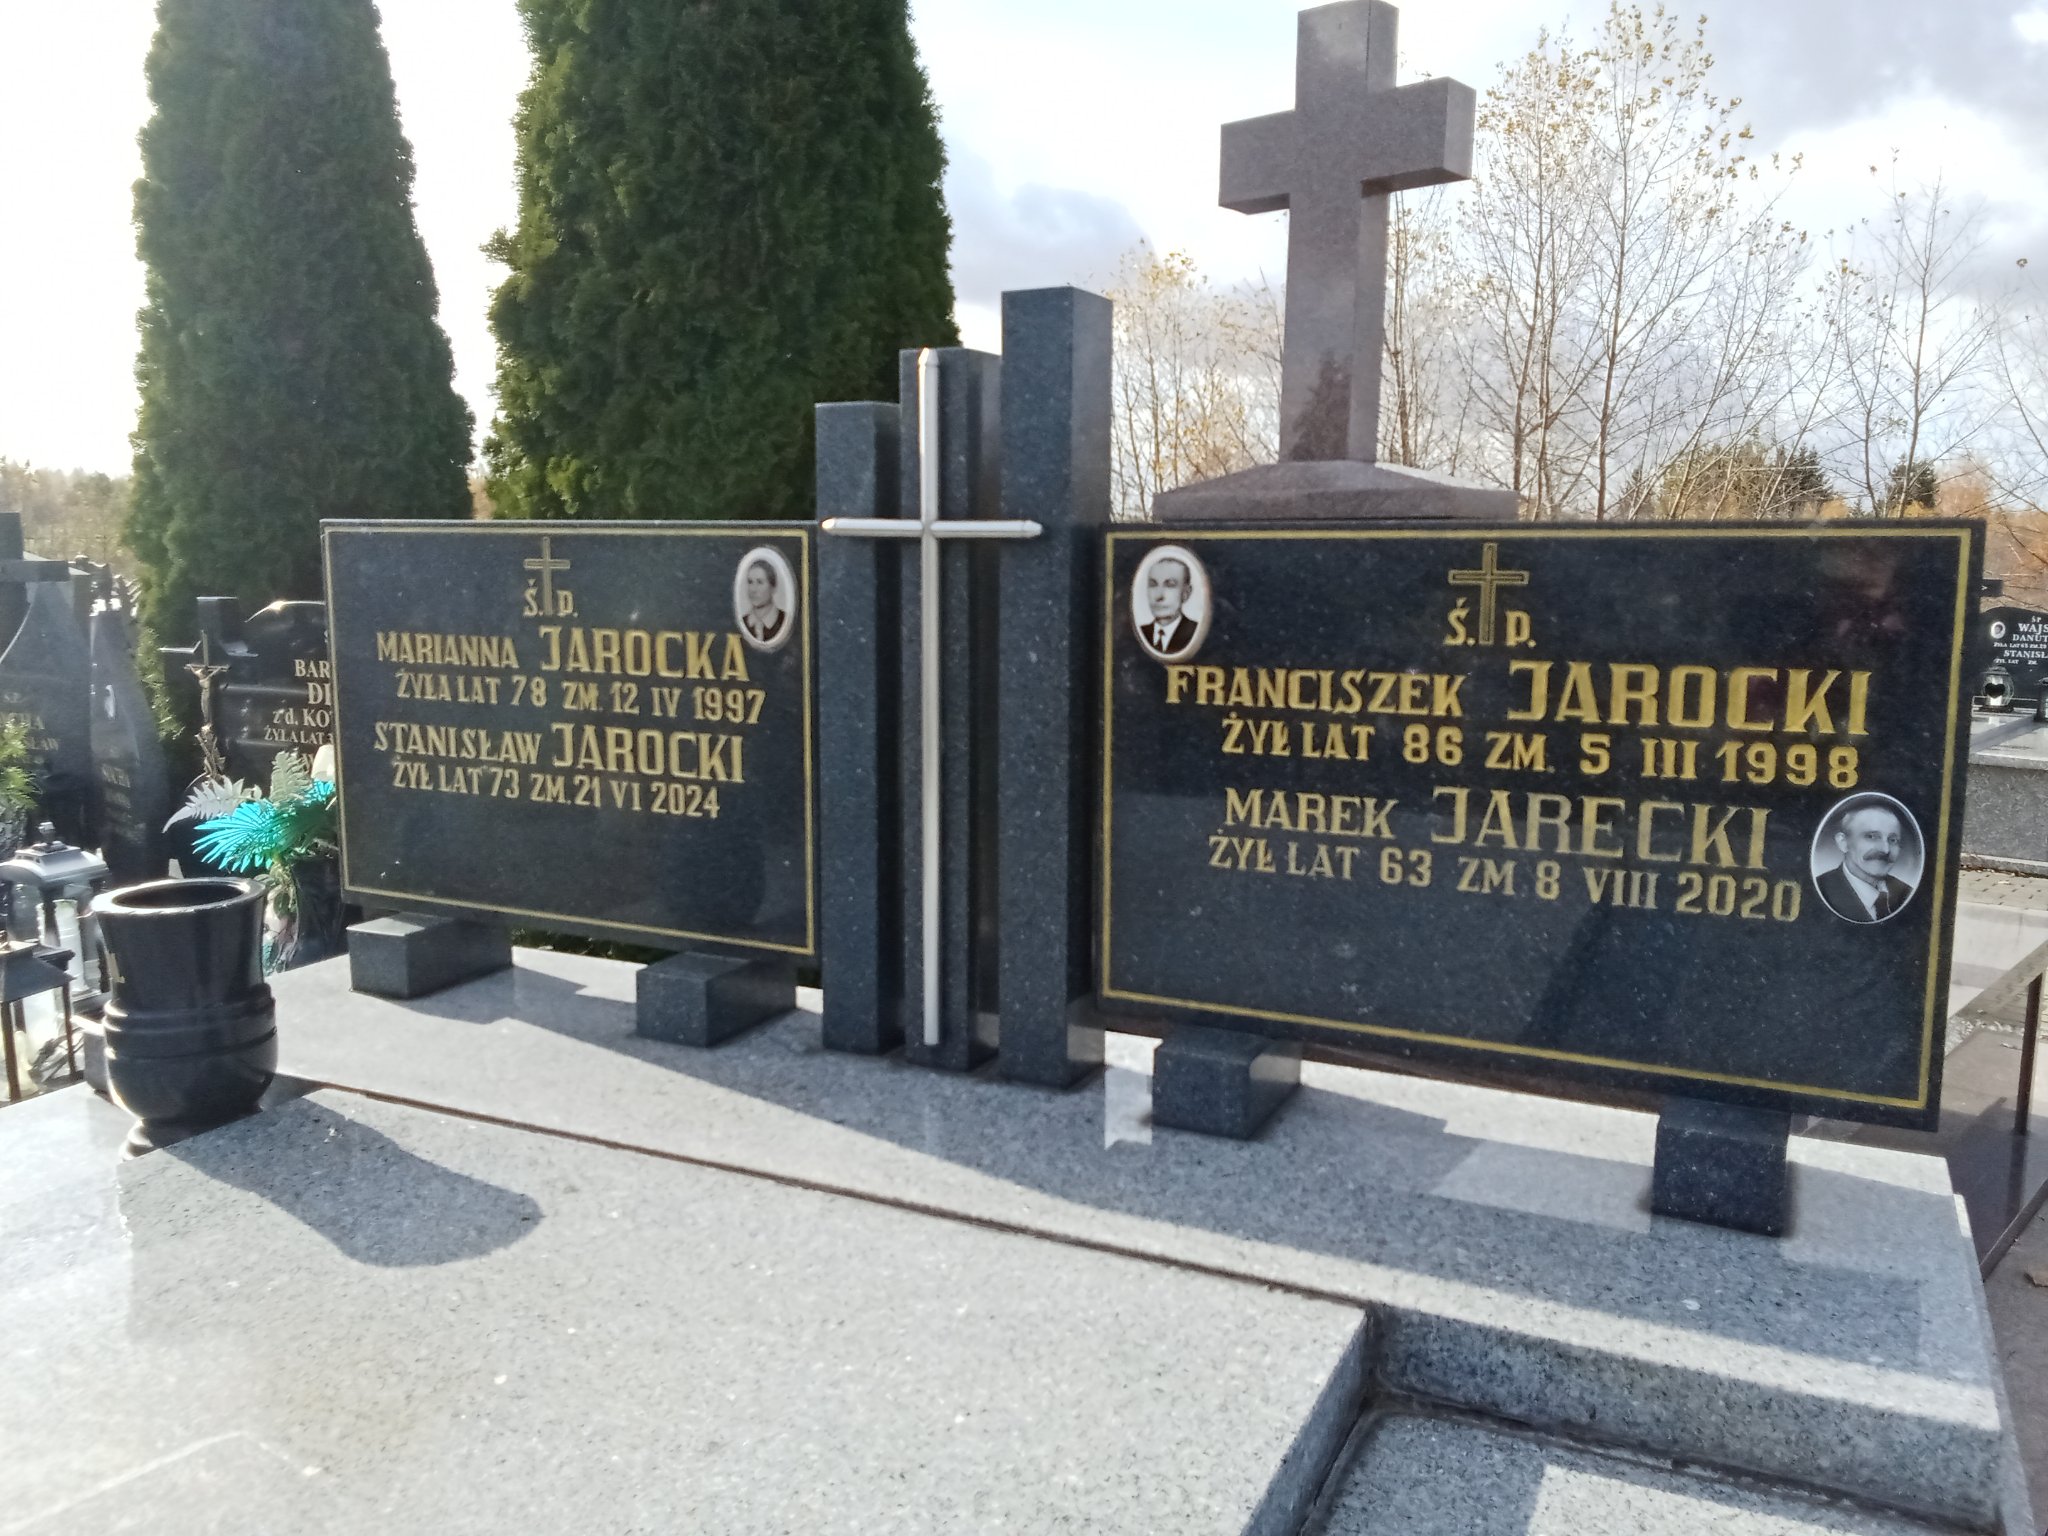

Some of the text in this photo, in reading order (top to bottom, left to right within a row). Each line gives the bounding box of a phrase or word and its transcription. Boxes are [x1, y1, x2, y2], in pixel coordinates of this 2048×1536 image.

[376, 625, 751, 682] MARIANNA JAROCKA
[456, 674, 502, 705] LAT
[510, 673, 549, 708] 78
[609, 679, 641, 716] 12
[650, 685, 683, 719] IV
[691, 685, 767, 725] 1997
[1165, 659, 1873, 736] FRANCISZEK JAROCKI
[373, 720, 543, 766] STANISŁAW
[550, 721, 746, 784] JAROCKI
[1300, 720, 1376, 762] LAT
[1401, 722, 1465, 767] 86
[1578, 732, 1611, 776] 5
[1640, 736, 1699, 781] III
[1714, 739, 1861, 790] 1998
[437, 763, 483, 796] LAT
[489, 764, 521, 800] 73
[572, 773, 602, 809] 21
[608, 779, 643, 812] VI
[650, 780, 721, 820] 2024
[1224, 785, 1773, 871] MAREK JARECKI
[1285, 841, 1361, 880] LAT
[1379, 846, 1433, 888] 63
[1534, 859, 1562, 901] 8
[1582, 865, 1661, 910] VIII
[1675, 871, 1802, 923] 2020
